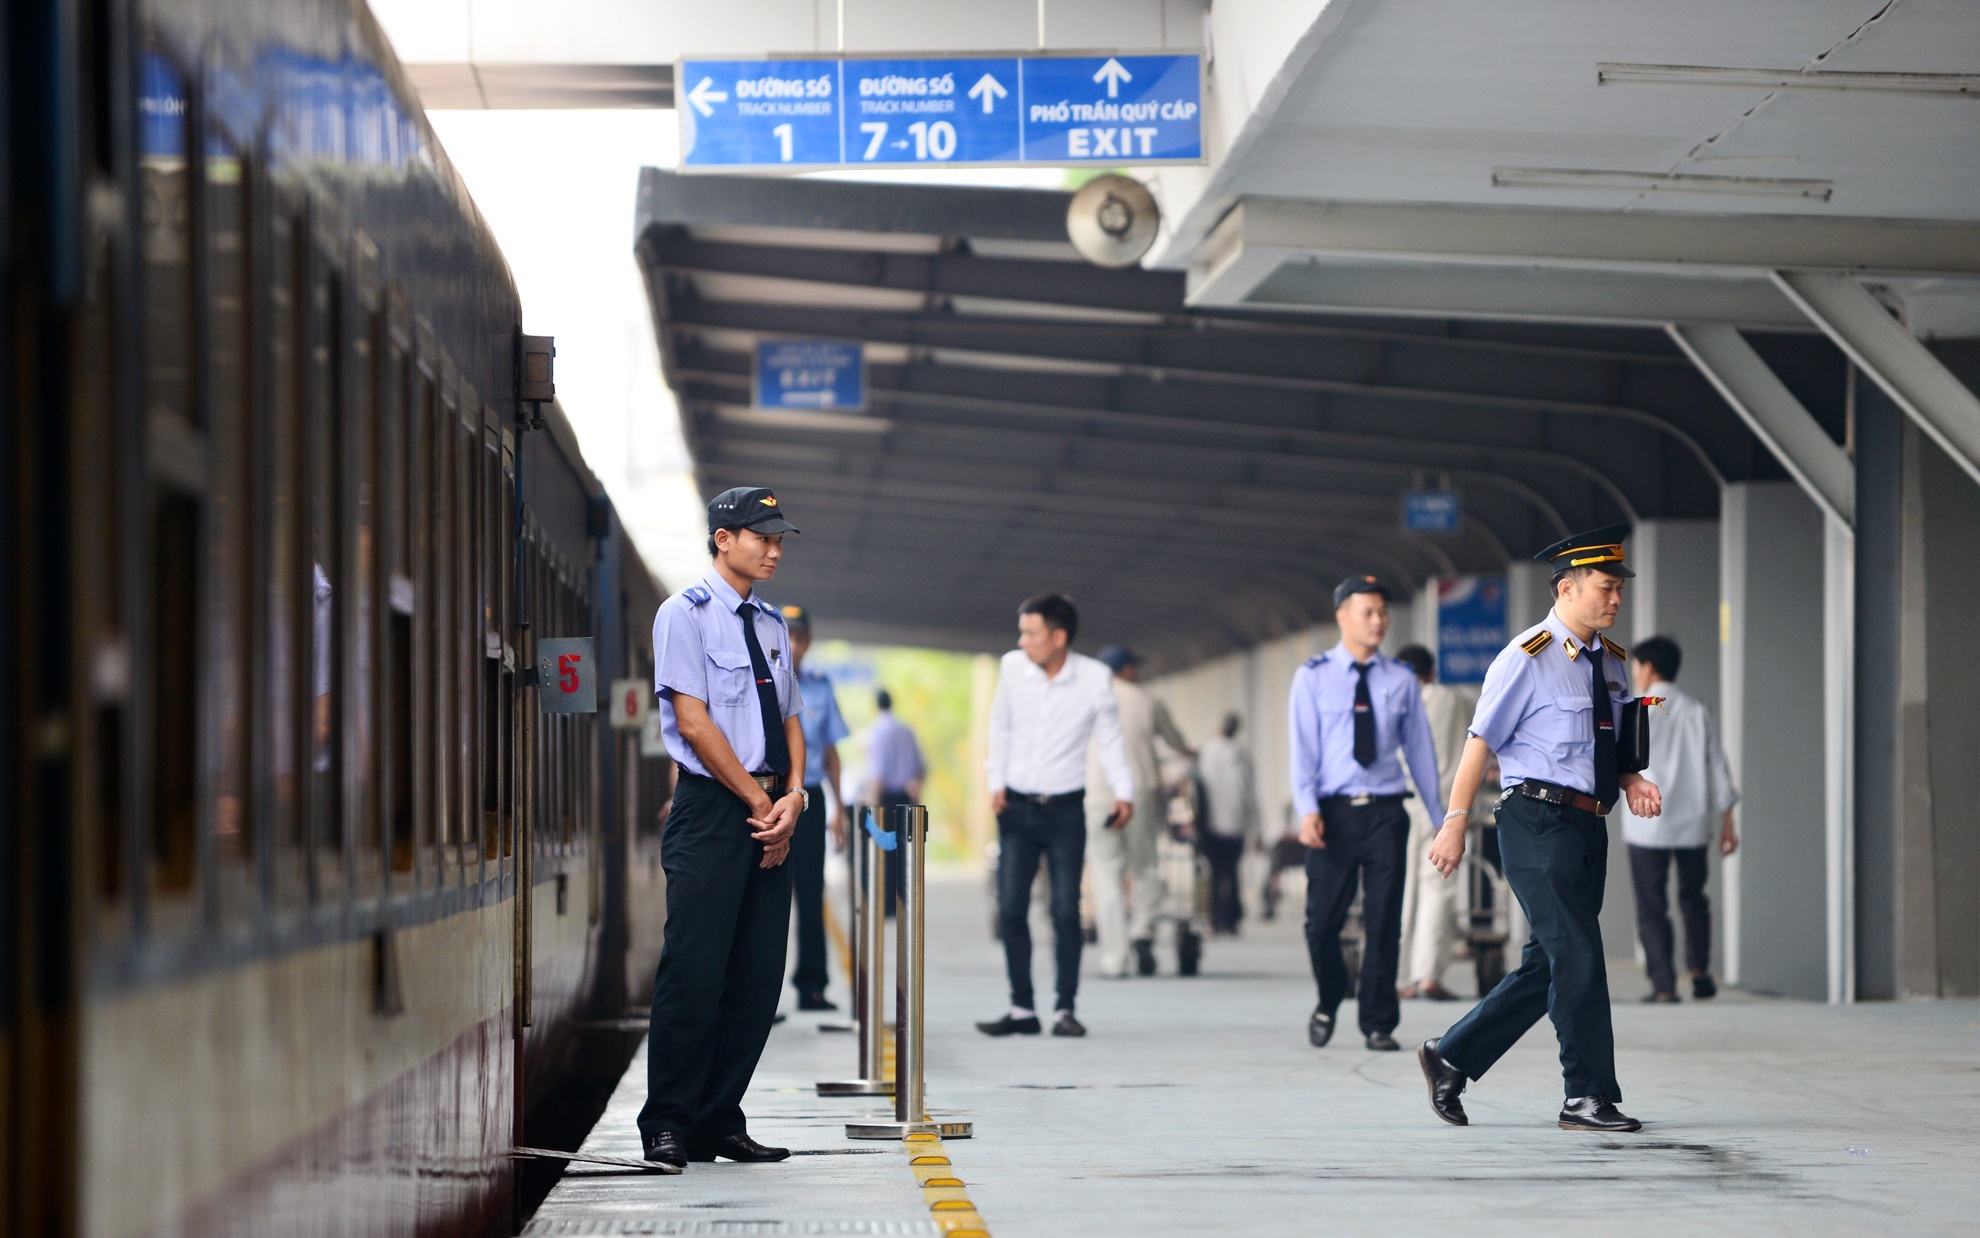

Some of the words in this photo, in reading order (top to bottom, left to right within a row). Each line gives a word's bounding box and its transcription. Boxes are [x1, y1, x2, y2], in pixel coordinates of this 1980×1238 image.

[805, 74, 832, 98] SỐ
[928, 72, 955, 96] SỐ
[737, 101, 777, 115] TRACK
[778, 101, 832, 115] NUMBER
[861, 100, 900, 114] TRACK
[901, 99, 955, 113] NUMBER
[1030, 99, 1070, 122] PHỐ
[1120, 99, 1159, 123] QUÝ
[1160, 99, 1198, 121] CÁP
[773, 123, 793, 162] 1
[908, 120, 957, 160] 10
[1068, 127, 1158, 157] EXIT
[558, 653, 581, 694] 5
